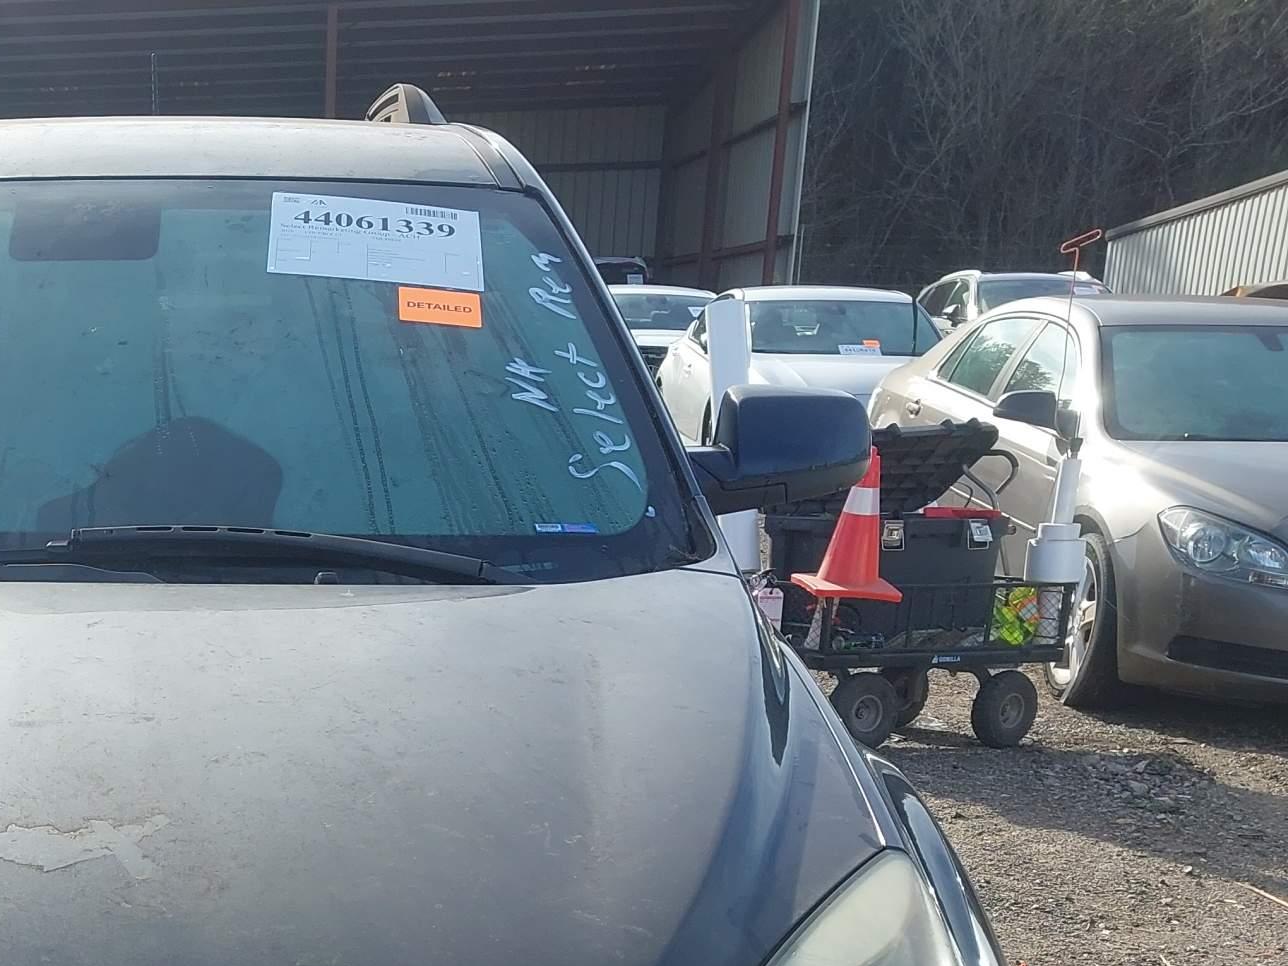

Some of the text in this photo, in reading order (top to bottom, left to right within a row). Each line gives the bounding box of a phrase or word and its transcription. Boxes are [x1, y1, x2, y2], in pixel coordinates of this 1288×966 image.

[294, 210, 456, 238] 44061339
[407, 300, 473, 314] DETAILED
[554, 342, 642, 491] Select
